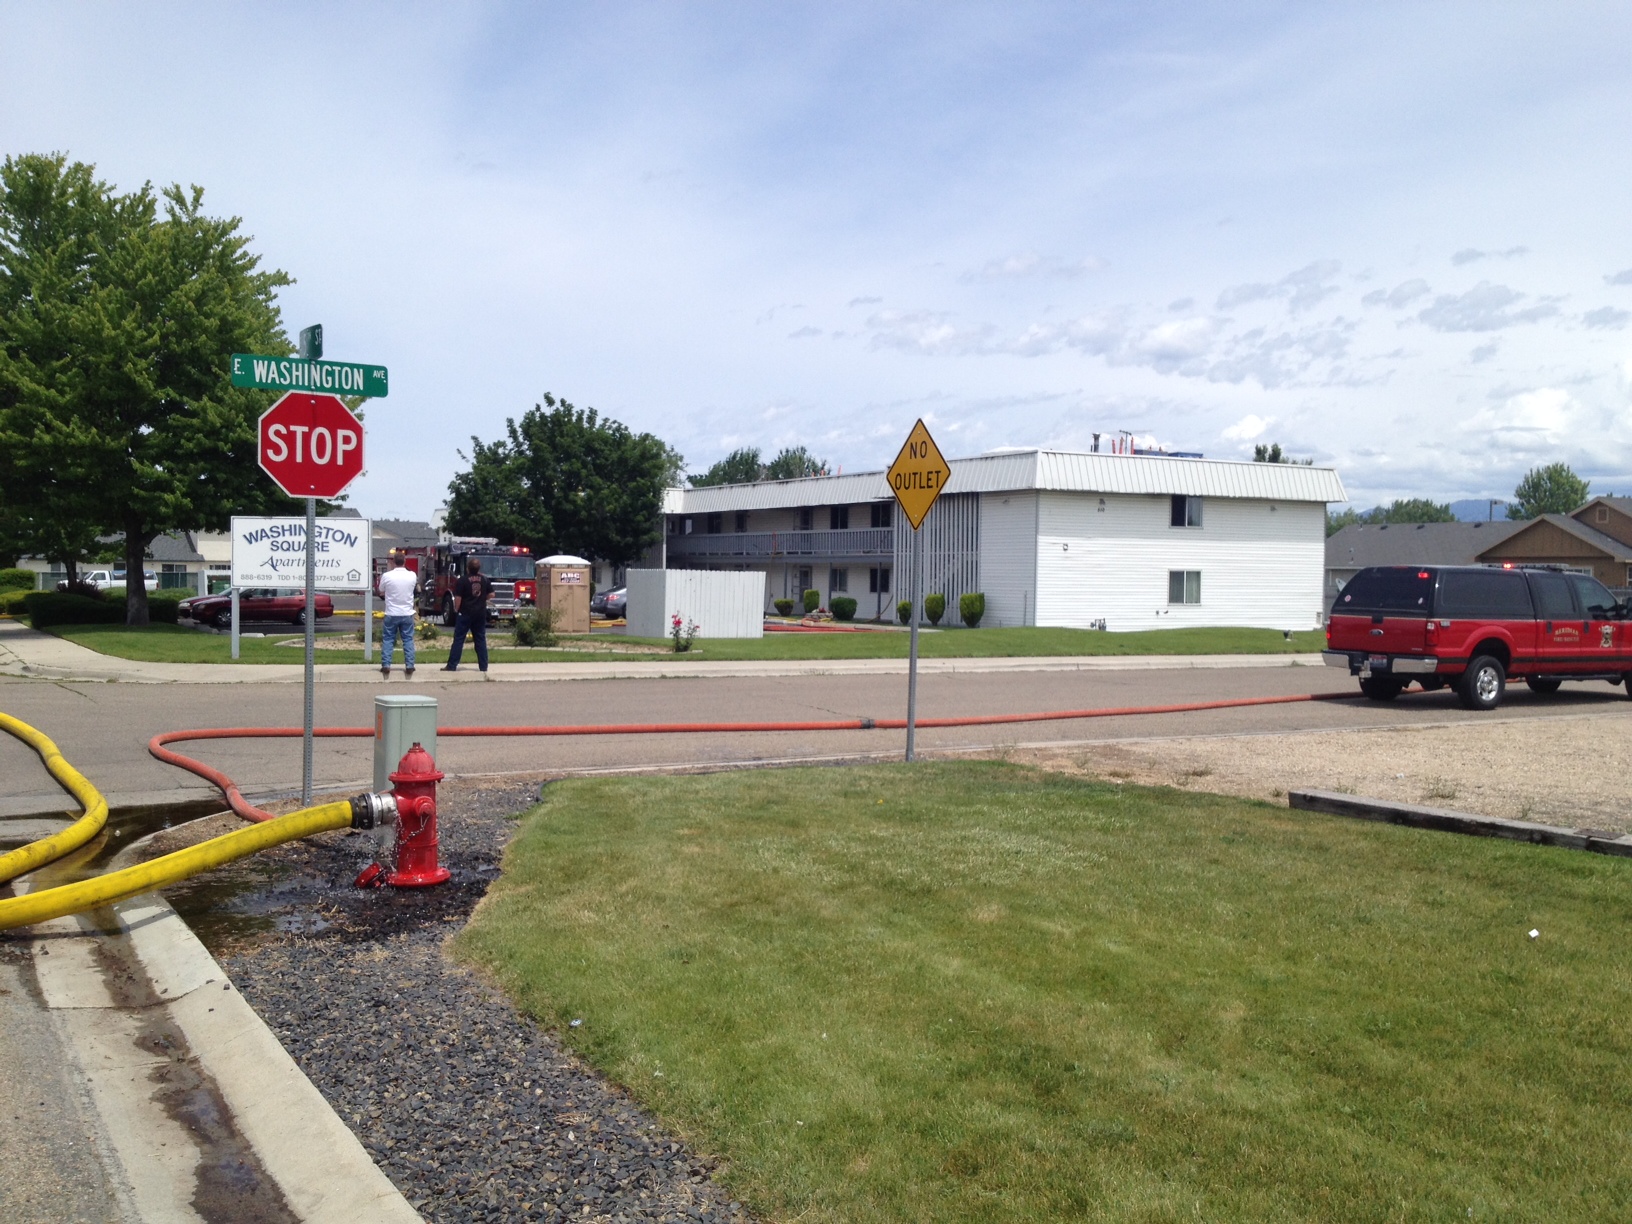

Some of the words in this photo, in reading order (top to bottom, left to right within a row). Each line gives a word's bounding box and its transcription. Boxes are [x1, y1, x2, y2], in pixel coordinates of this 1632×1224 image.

[253, 359, 364, 390] WASHINGTON
[266, 423, 358, 466] STOP
[909, 440, 927, 459] NO
[894, 470, 942, 491] OUTLET
[242, 523, 359, 548] WASHINGTON
[270, 540, 330, 552] SQUARE
